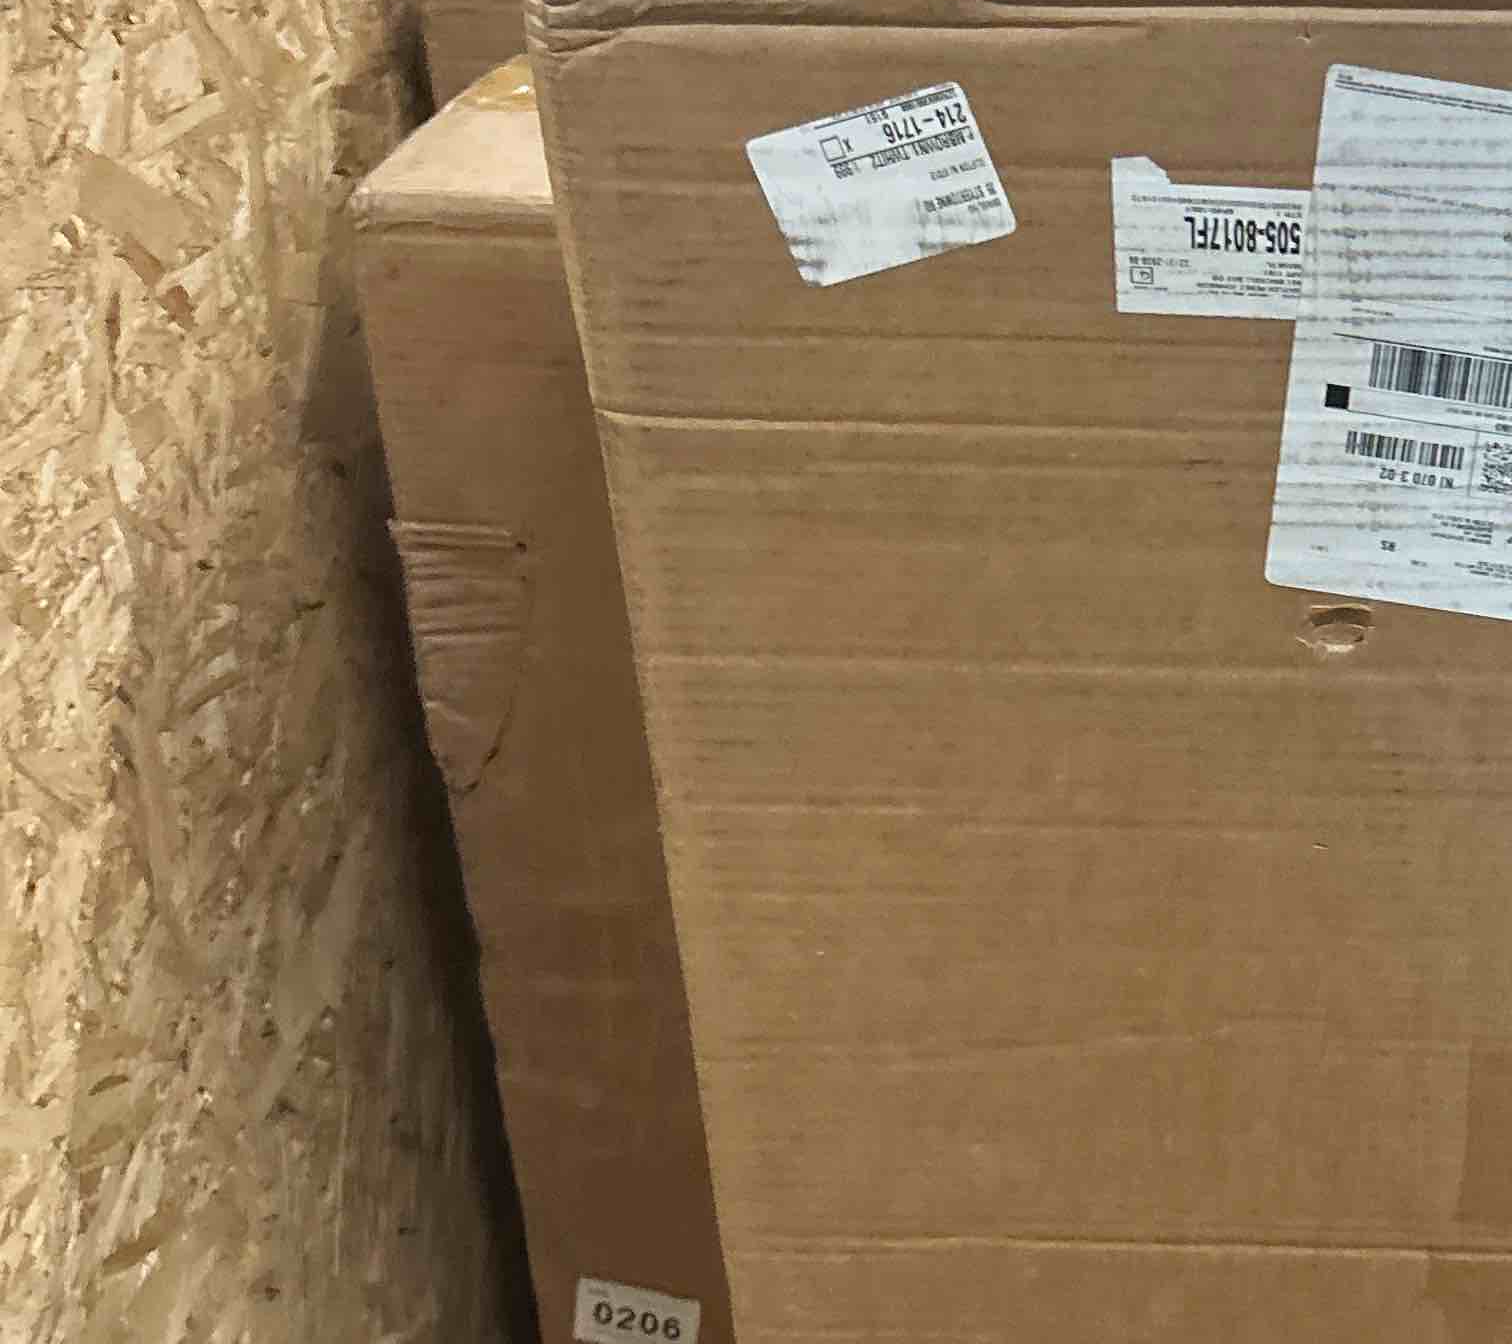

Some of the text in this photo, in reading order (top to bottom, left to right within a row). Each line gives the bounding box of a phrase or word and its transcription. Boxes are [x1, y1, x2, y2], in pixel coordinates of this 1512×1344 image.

[882, 103, 968, 145] 214-1716
[1183, 216, 1301, 254] 505-8017FL
[592, 1300, 681, 1341] 0206
